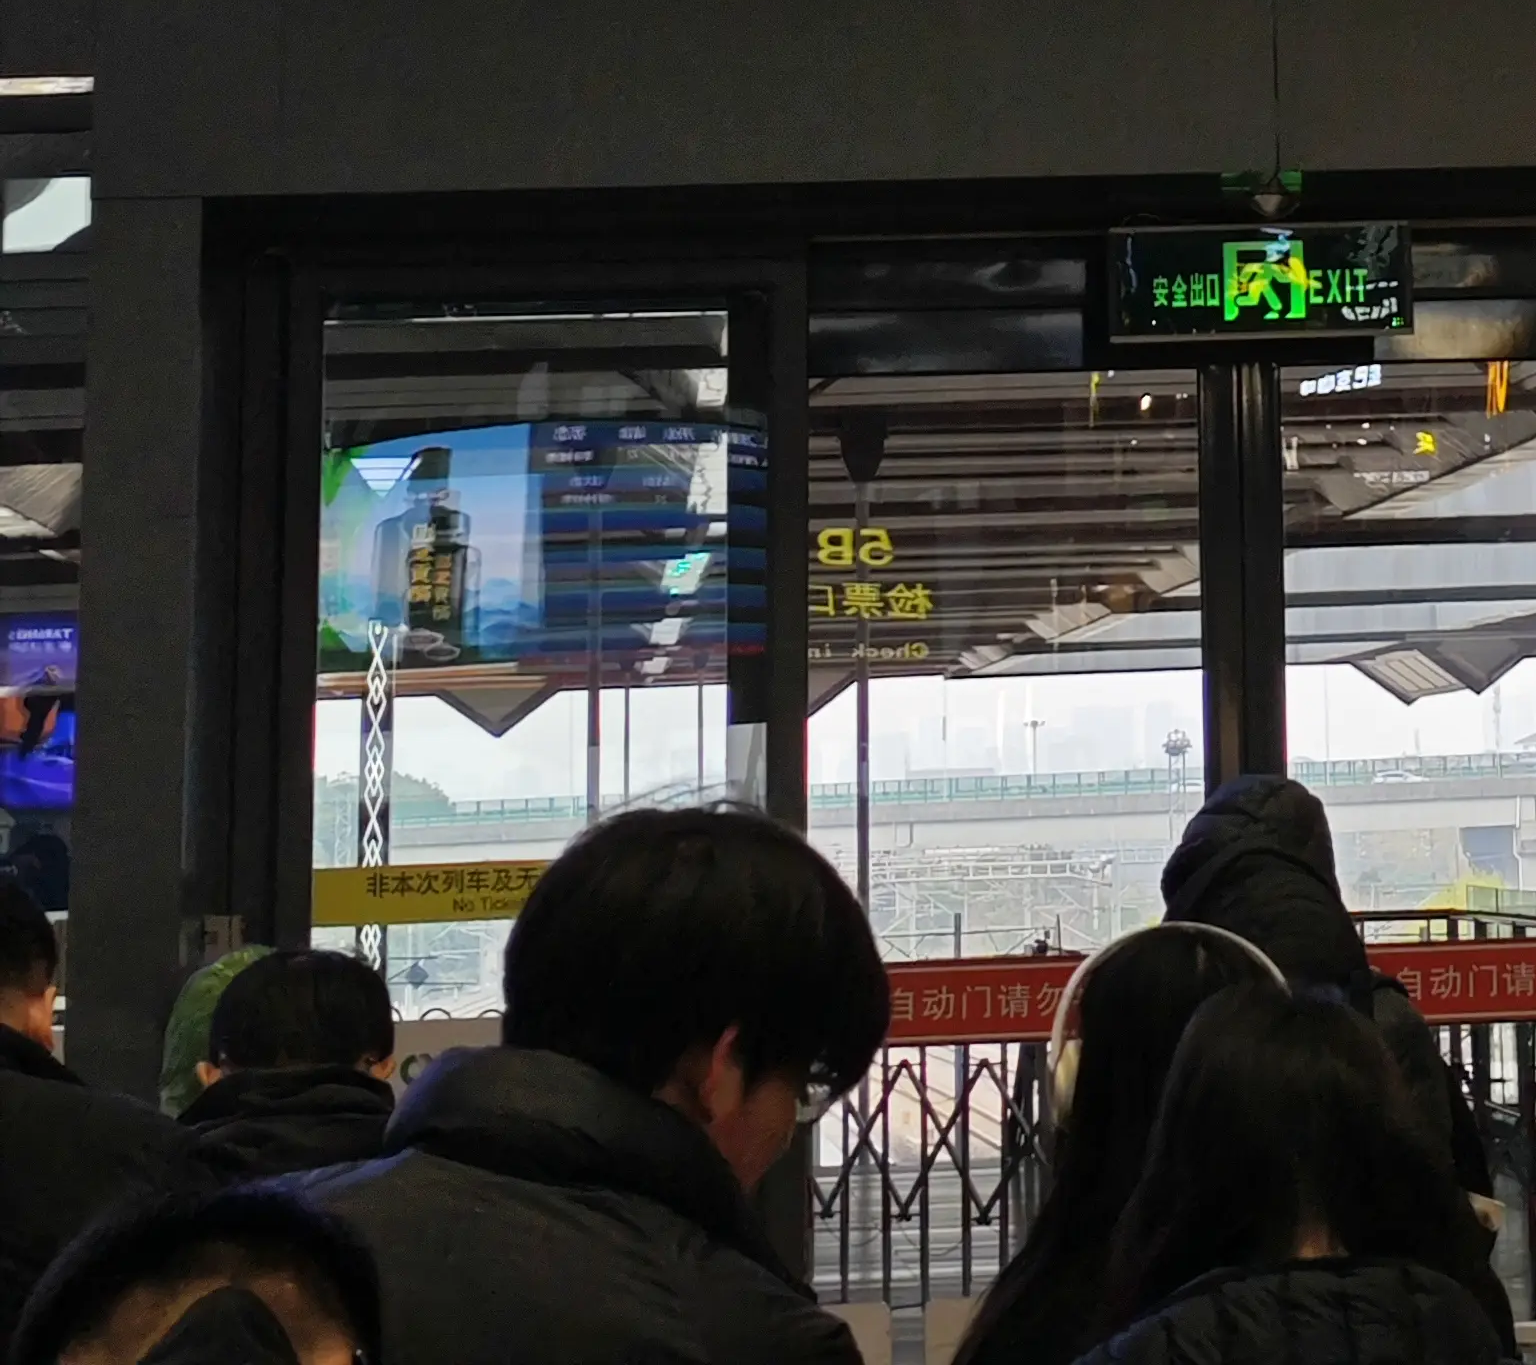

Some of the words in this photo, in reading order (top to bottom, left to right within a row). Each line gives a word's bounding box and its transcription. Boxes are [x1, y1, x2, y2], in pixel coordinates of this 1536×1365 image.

[1152, 272, 1220, 308] 安全出口
[1308, 268, 1369, 305] EXIT
[365, 867, 540, 899] 非本次列车及无
[452, 896, 476, 913] No
[891, 981, 1082, 1022] 自动门请勿
